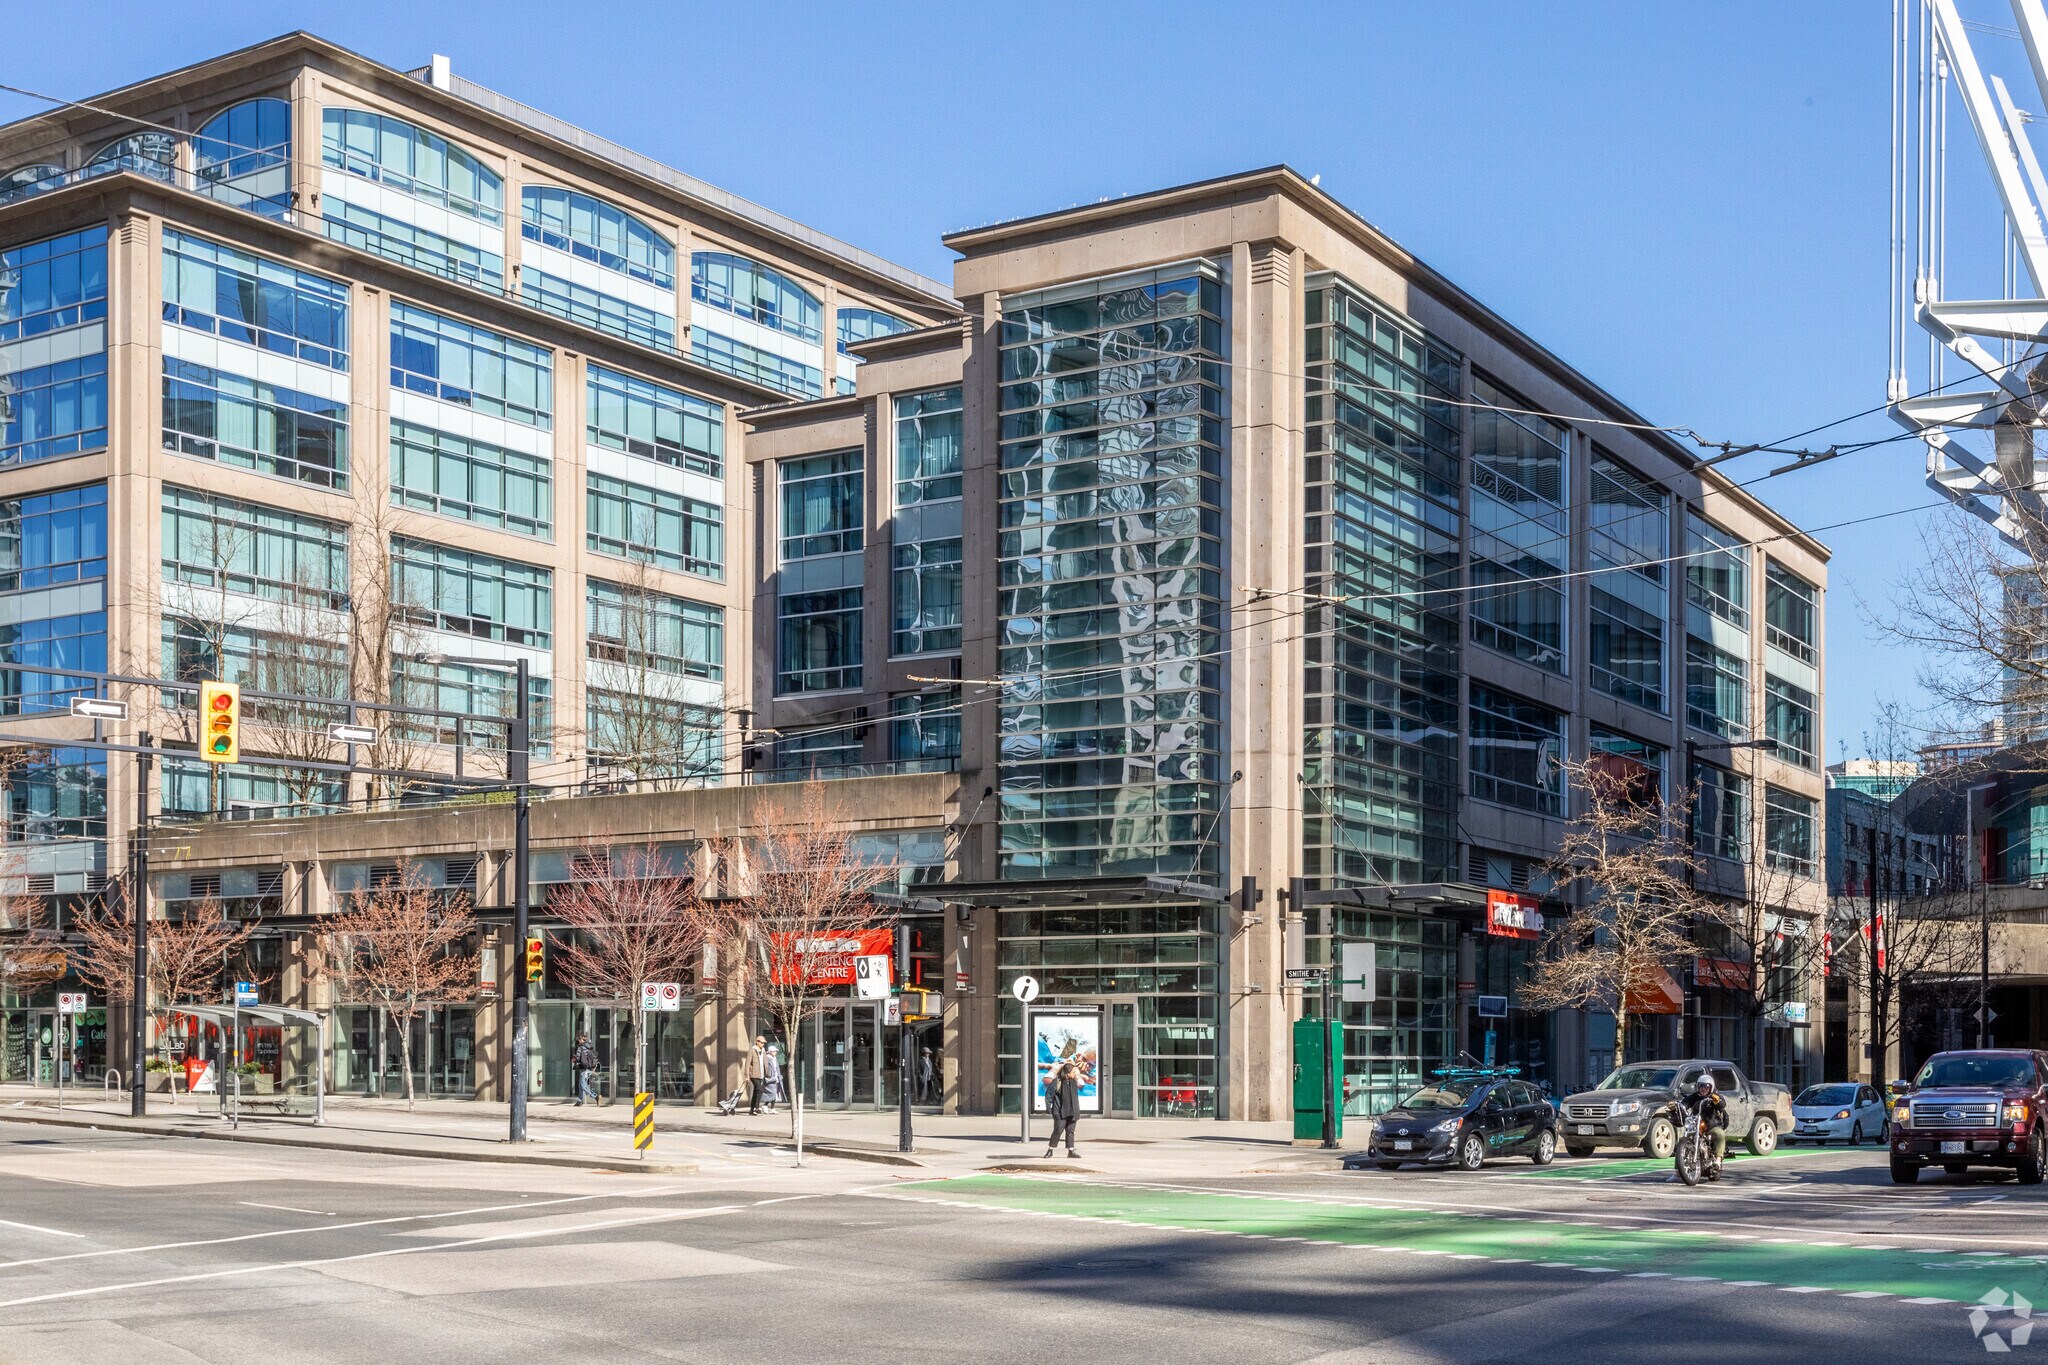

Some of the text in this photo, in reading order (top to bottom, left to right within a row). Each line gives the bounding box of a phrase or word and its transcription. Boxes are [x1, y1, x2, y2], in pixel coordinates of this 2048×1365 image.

[810, 967, 849, 978] CENTRE
[1288, 970, 1310, 978] SMITHE
[240, 983, 247, 992] T
[1489, 1134, 1505, 1145] evo
